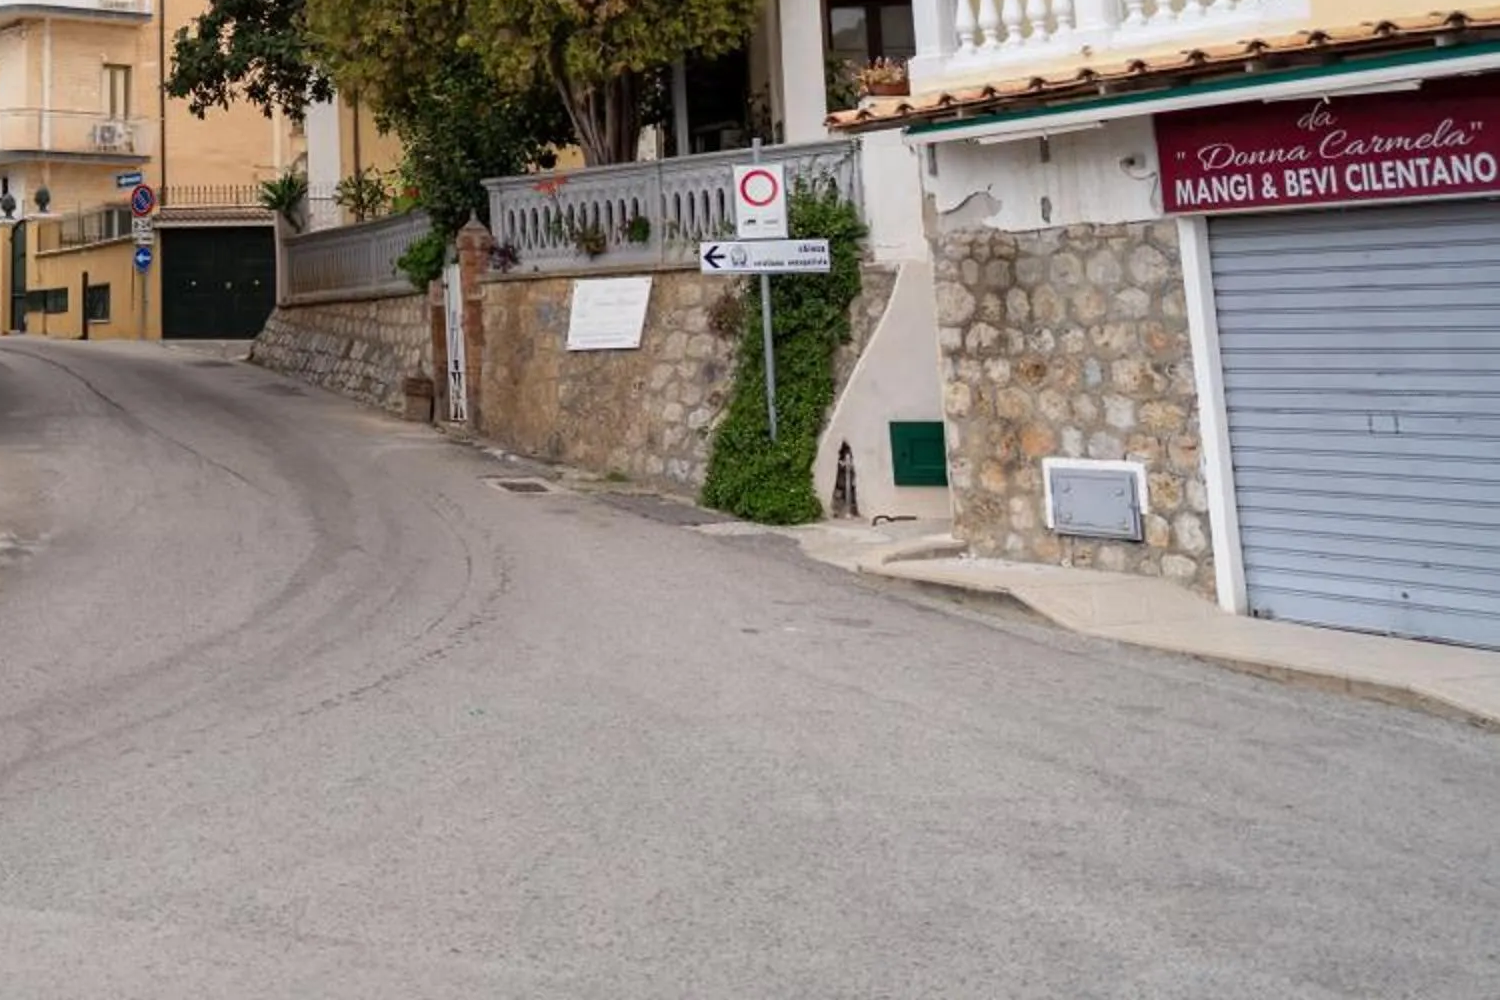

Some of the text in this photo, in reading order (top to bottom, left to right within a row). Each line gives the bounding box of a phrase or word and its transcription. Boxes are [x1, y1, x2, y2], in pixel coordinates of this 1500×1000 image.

[1297, 101, 1337, 131] da
[1175, 152, 1497, 206] MANGI & BEVI CILENTANO
